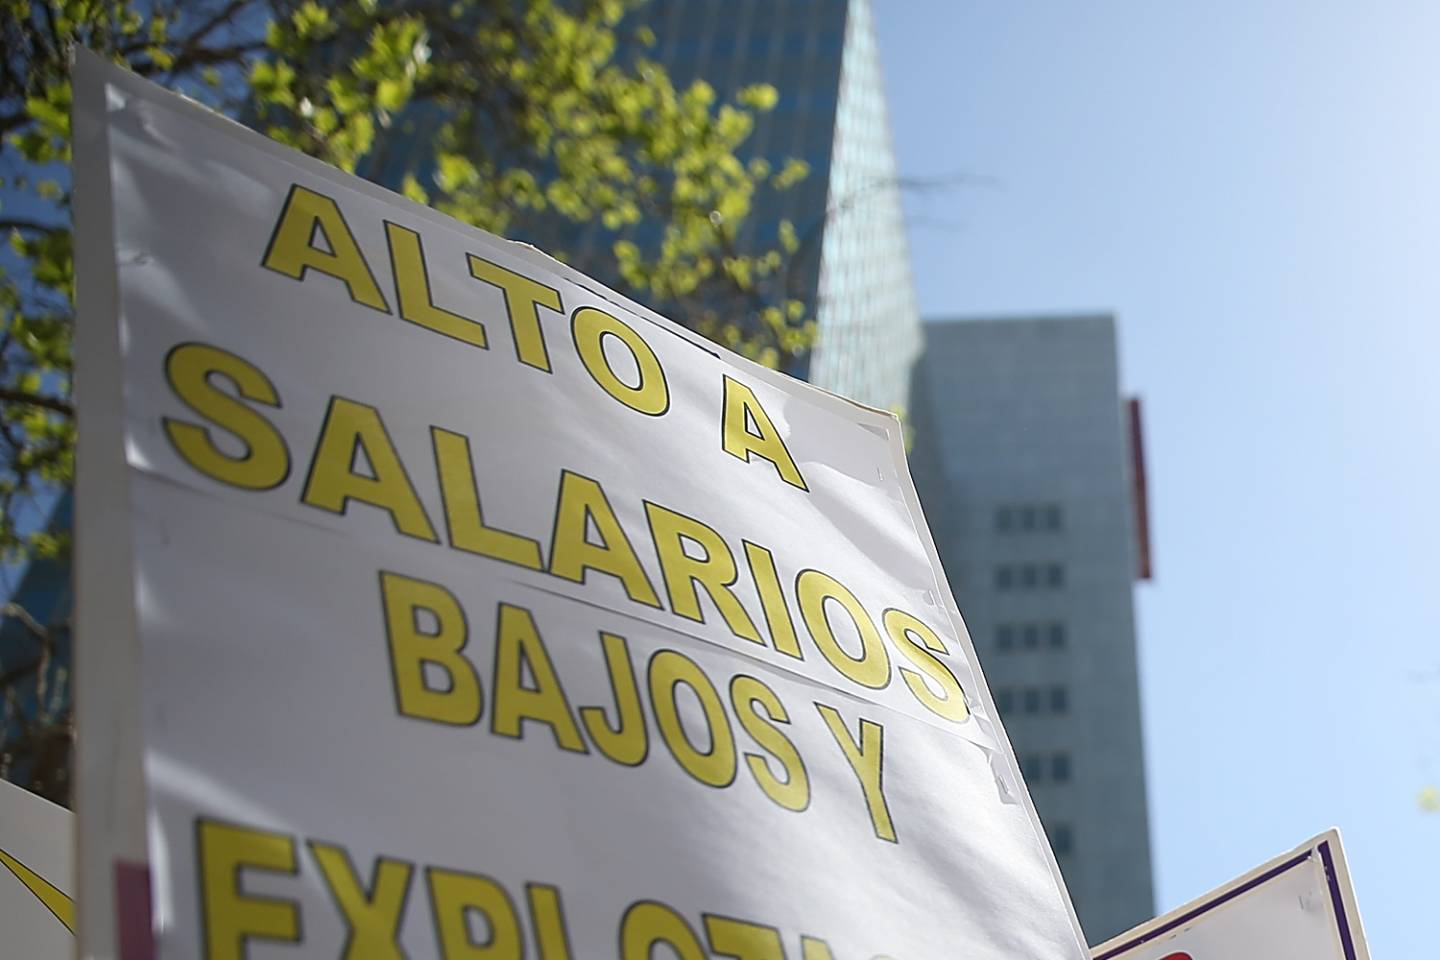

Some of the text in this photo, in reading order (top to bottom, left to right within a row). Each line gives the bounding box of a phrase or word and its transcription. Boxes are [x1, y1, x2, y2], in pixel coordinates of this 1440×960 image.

[261, 183, 810, 493] ALTO A
[161, 341, 972, 724] SALARIOS
[379, 570, 899, 845] BAJOS Y
